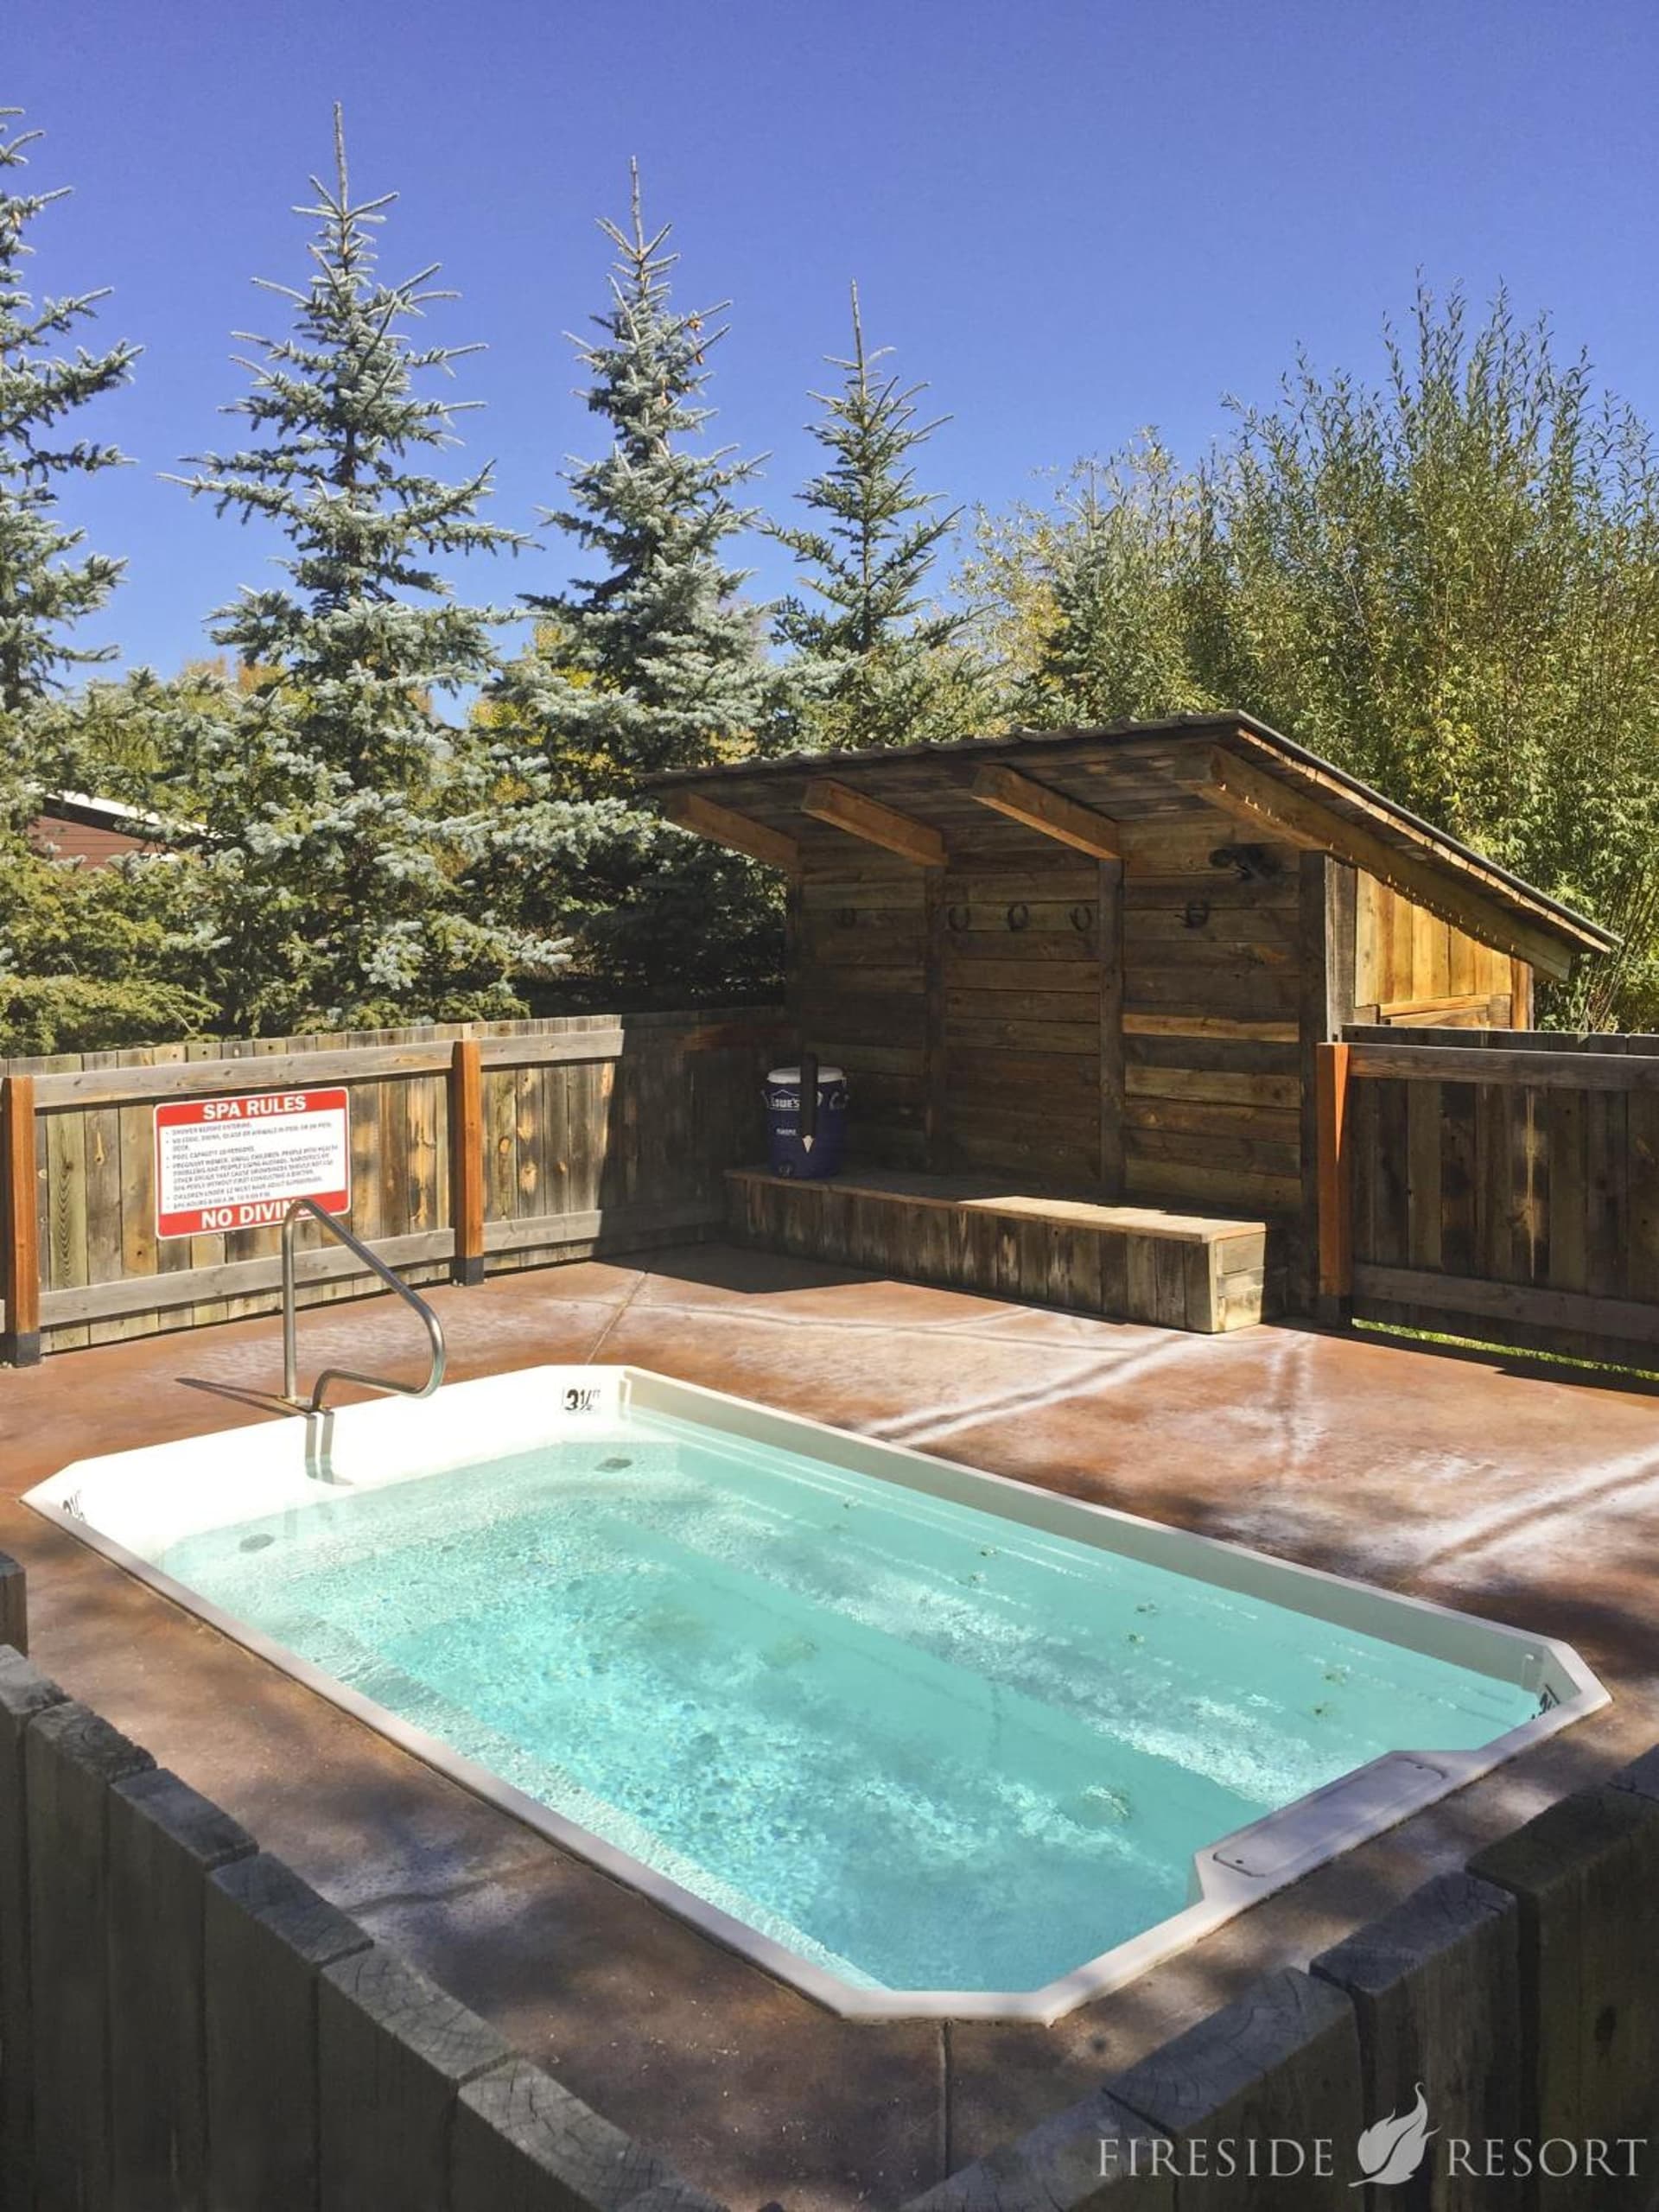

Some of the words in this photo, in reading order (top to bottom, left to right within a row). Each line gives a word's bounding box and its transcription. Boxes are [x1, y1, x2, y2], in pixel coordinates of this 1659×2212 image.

[203, 1102, 241, 1120] SPA
[246, 1096, 307, 1116] RULES
[201, 1208, 233, 1229] NO
[239, 1198, 312, 1224] DIVIN
